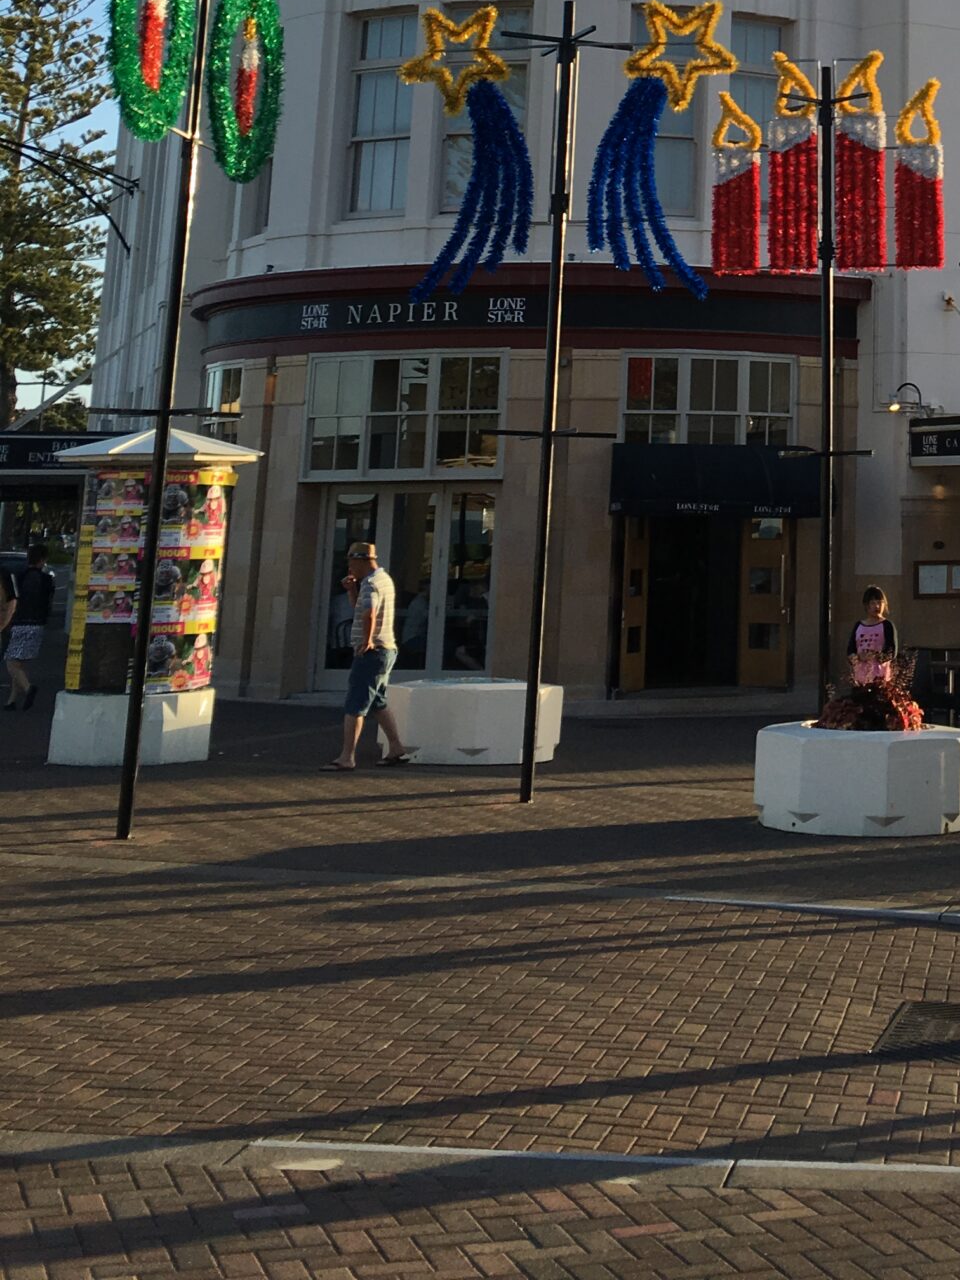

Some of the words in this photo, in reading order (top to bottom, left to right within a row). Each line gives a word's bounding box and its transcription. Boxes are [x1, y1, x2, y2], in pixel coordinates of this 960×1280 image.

[488, 297, 526, 310] LONE
[302, 304, 330, 317] LONE
[346, 301, 459, 325] NAPIER
[922, 435, 938, 445] LONE
